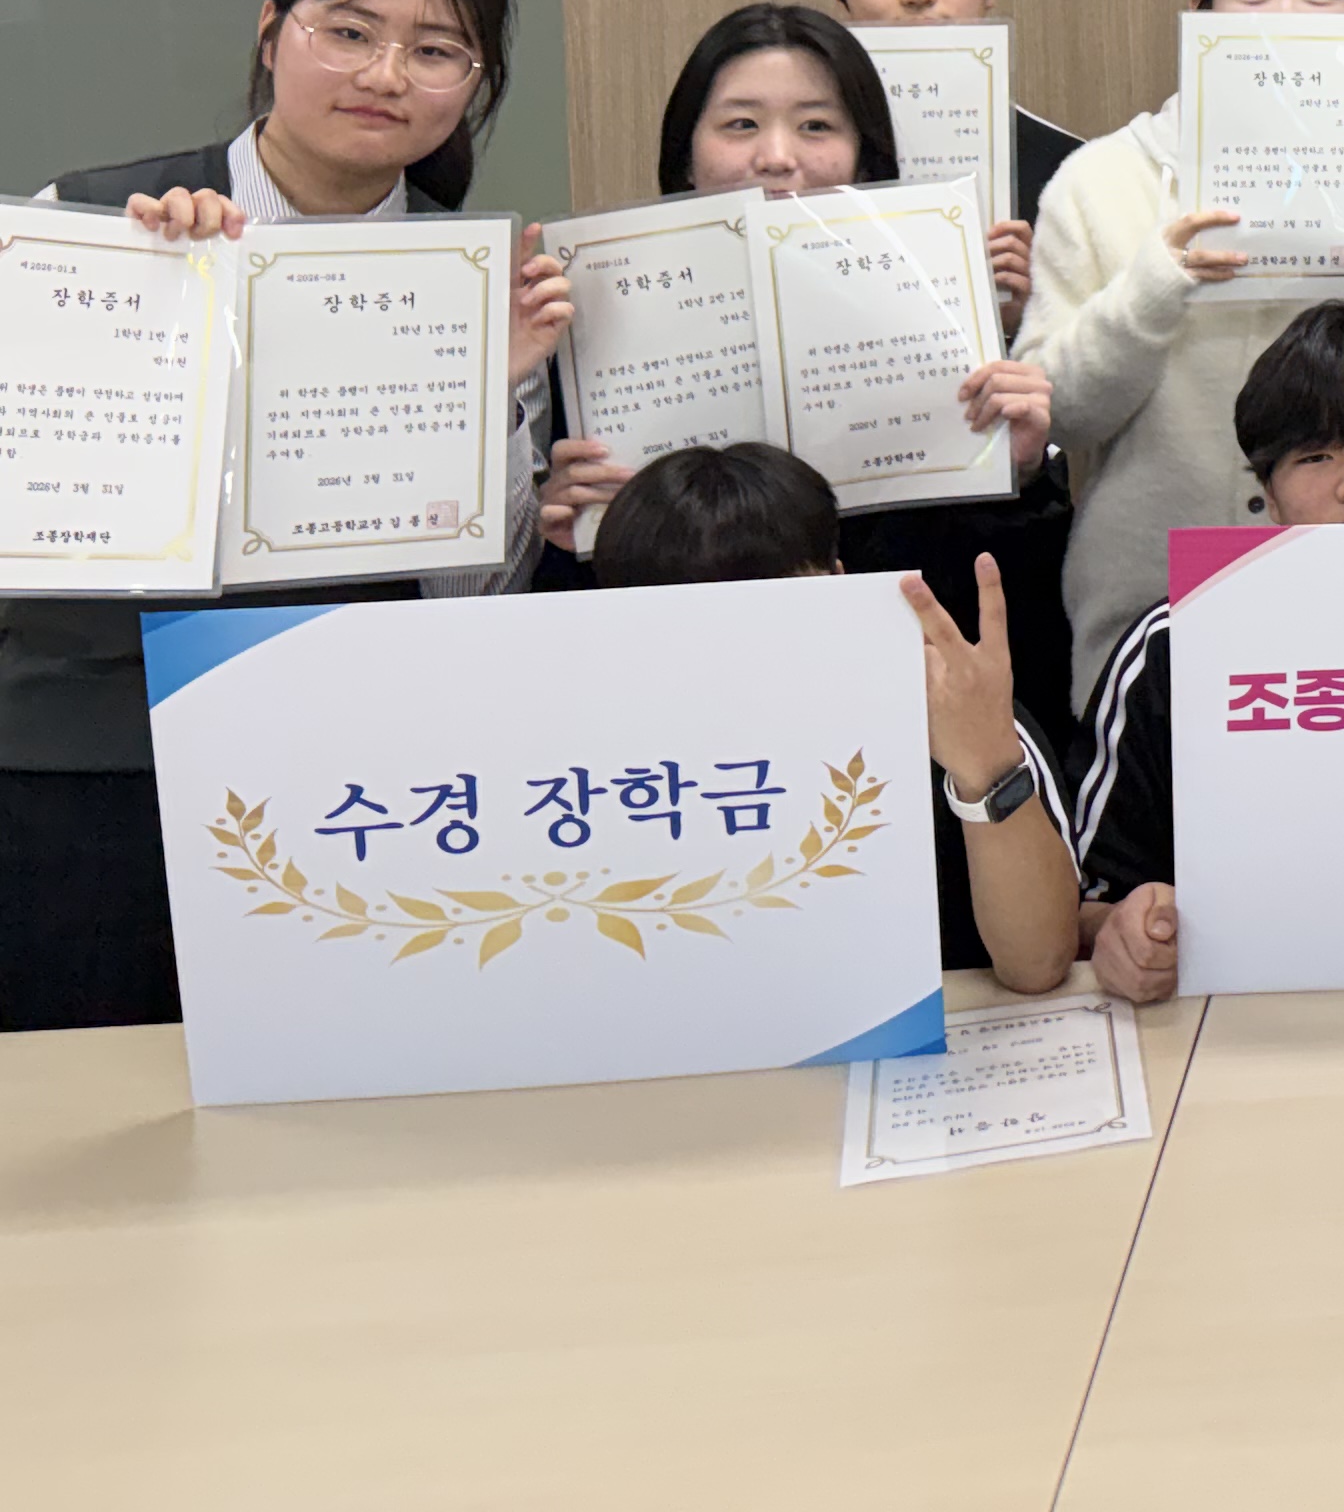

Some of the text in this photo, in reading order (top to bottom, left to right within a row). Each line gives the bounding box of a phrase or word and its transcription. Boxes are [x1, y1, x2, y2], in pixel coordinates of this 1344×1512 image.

[888, 84, 938, 101] 학증서
[314, 759, 787, 862] 수경 장학금
